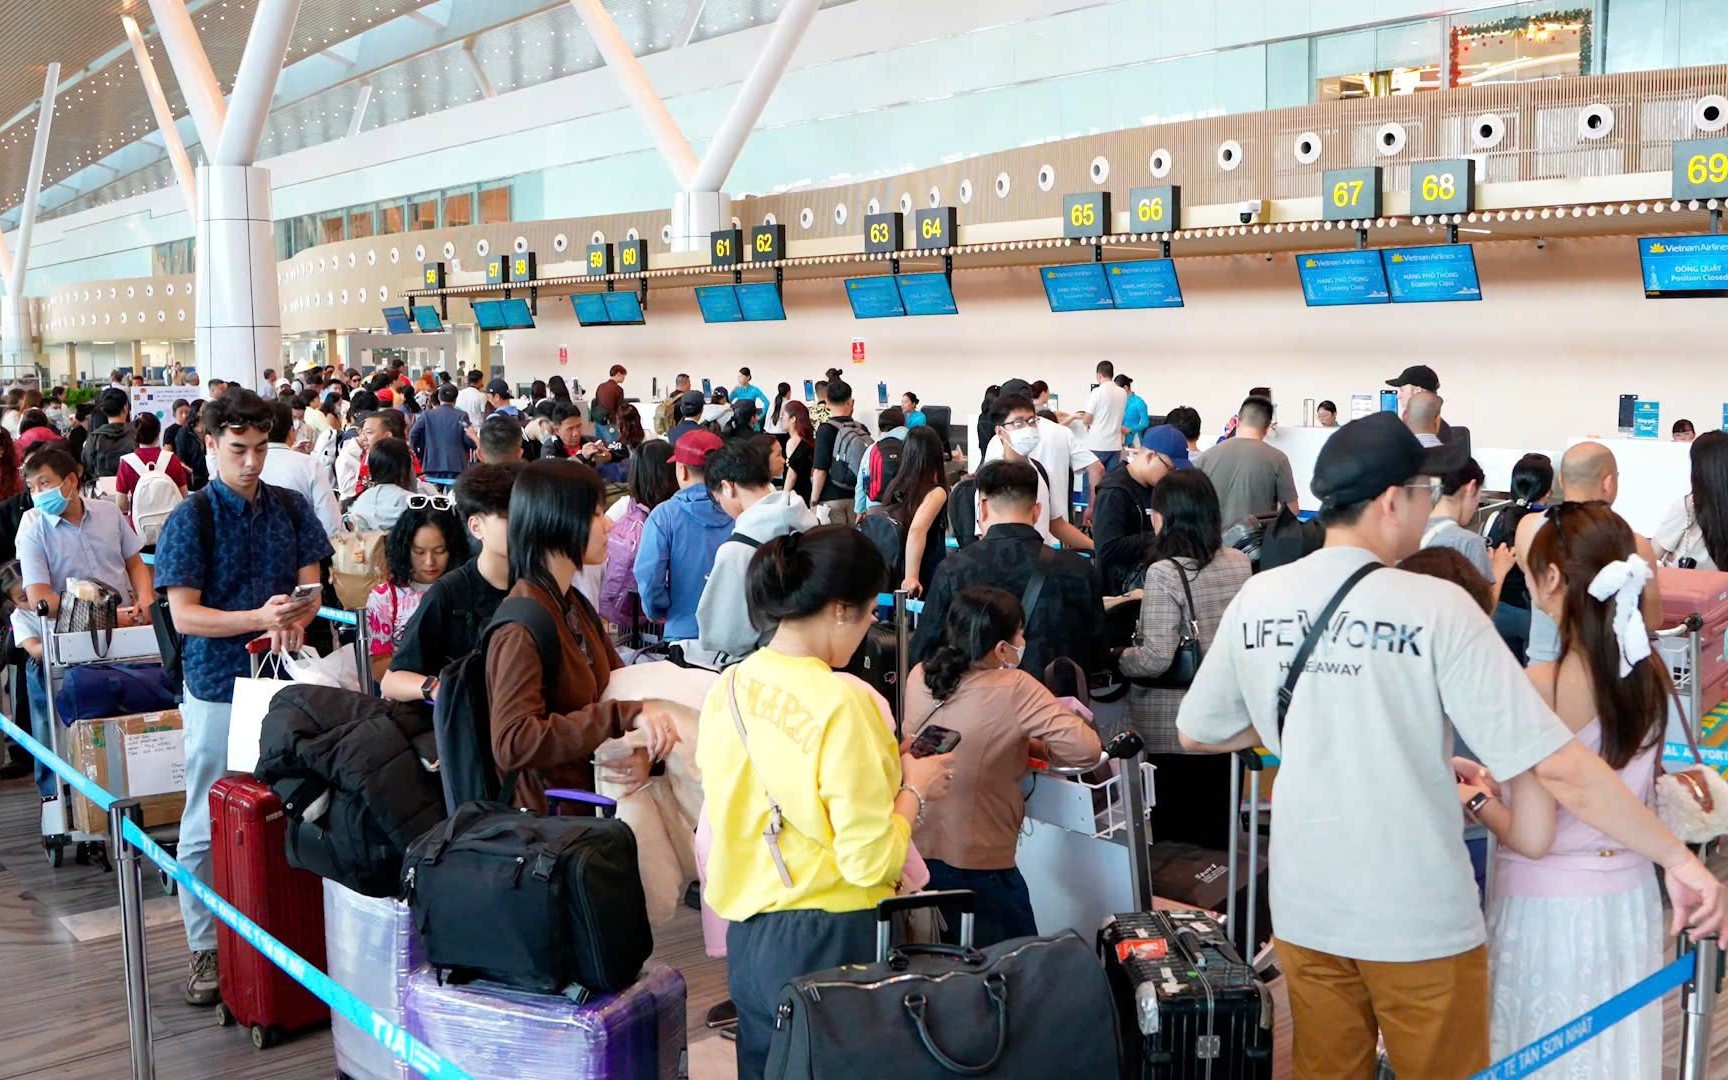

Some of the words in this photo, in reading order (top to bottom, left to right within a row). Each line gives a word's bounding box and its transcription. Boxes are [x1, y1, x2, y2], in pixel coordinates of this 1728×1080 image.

[1687, 152, 1728, 185] 69
[1332, 180, 1364, 207] 67
[1421, 175, 1456, 202] 68
[1070, 203, 1096, 227] 65
[1138, 197, 1163, 222] 66
[870, 223, 890, 242] 63
[922, 220, 942, 239] 64
[715, 240, 730, 257] 61
[756, 233, 773, 253] 62
[1665, 245, 1699, 253] Vietnam
[590, 251, 604, 268] 59
[621, 248, 637, 265] 60
[489, 262, 499, 278] 57
[515, 260, 527, 275] 58
[1702, 273, 1728, 281] Closed
[1279, 661, 1363, 677] HEAWAY
[370, 1011, 407, 1061] TIA
